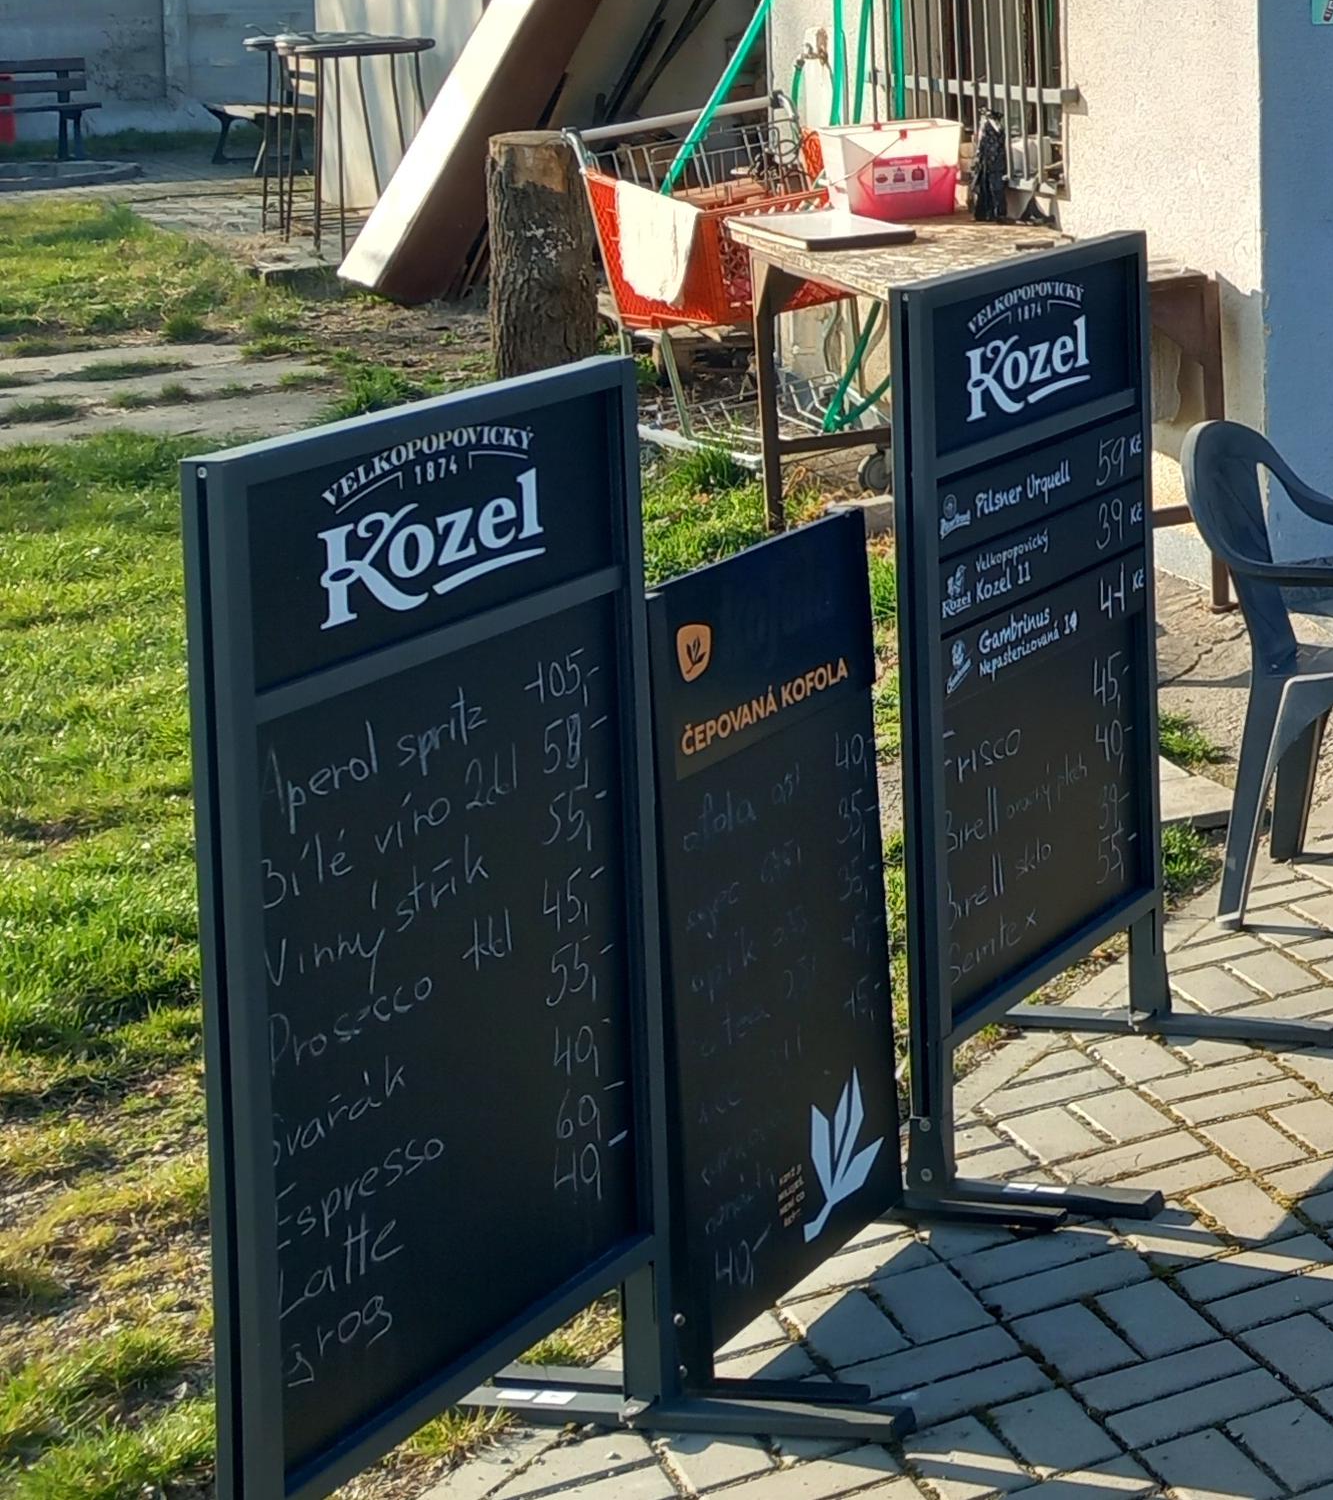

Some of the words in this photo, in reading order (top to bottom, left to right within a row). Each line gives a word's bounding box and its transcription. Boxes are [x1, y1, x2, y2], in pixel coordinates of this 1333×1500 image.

[968, 281, 1085, 333] VELKOPOPOVICKÝ
[1017, 304, 1042, 320] 1874
[966, 314, 1090, 423] Kozel
[321, 424, 534, 507] VELKOPOPOVICKÝ
[413, 456, 459, 486] 1874
[975, 484, 1022, 518] Pilsner
[1027, 460, 1070, 505] Urquell
[1096, 437, 1126, 486] 59
[1129, 433, 1143, 456] Kč
[318, 467, 545, 630] Kozel
[975, 528, 1049, 573] Velkopopovický
[1096, 498, 1123, 550] 39
[1130, 502, 1143, 525] Kč
[976, 571, 1012, 603] Kozel
[1017, 562, 1031, 585] 11
[978, 607, 1050, 655] Gambrinus
[1132, 567, 1144, 592] Kč
[979, 620, 1060, 681] Nepasterizovaná
[396, 686, 488, 776] spritz
[681, 685, 778, 756] ČEPOVANÁ
[781, 657, 848, 708] KOFOLA
[374, 792, 450, 854] víno
[1015, 840, 1052, 882] sklo
[264, 879, 386, 995] Vinný
[948, 908, 1039, 988] Semtex
[268, 977, 433, 1076] Prosecco
[276, 1138, 444, 1251] Espresso
[279, 1212, 404, 1320] Latte
